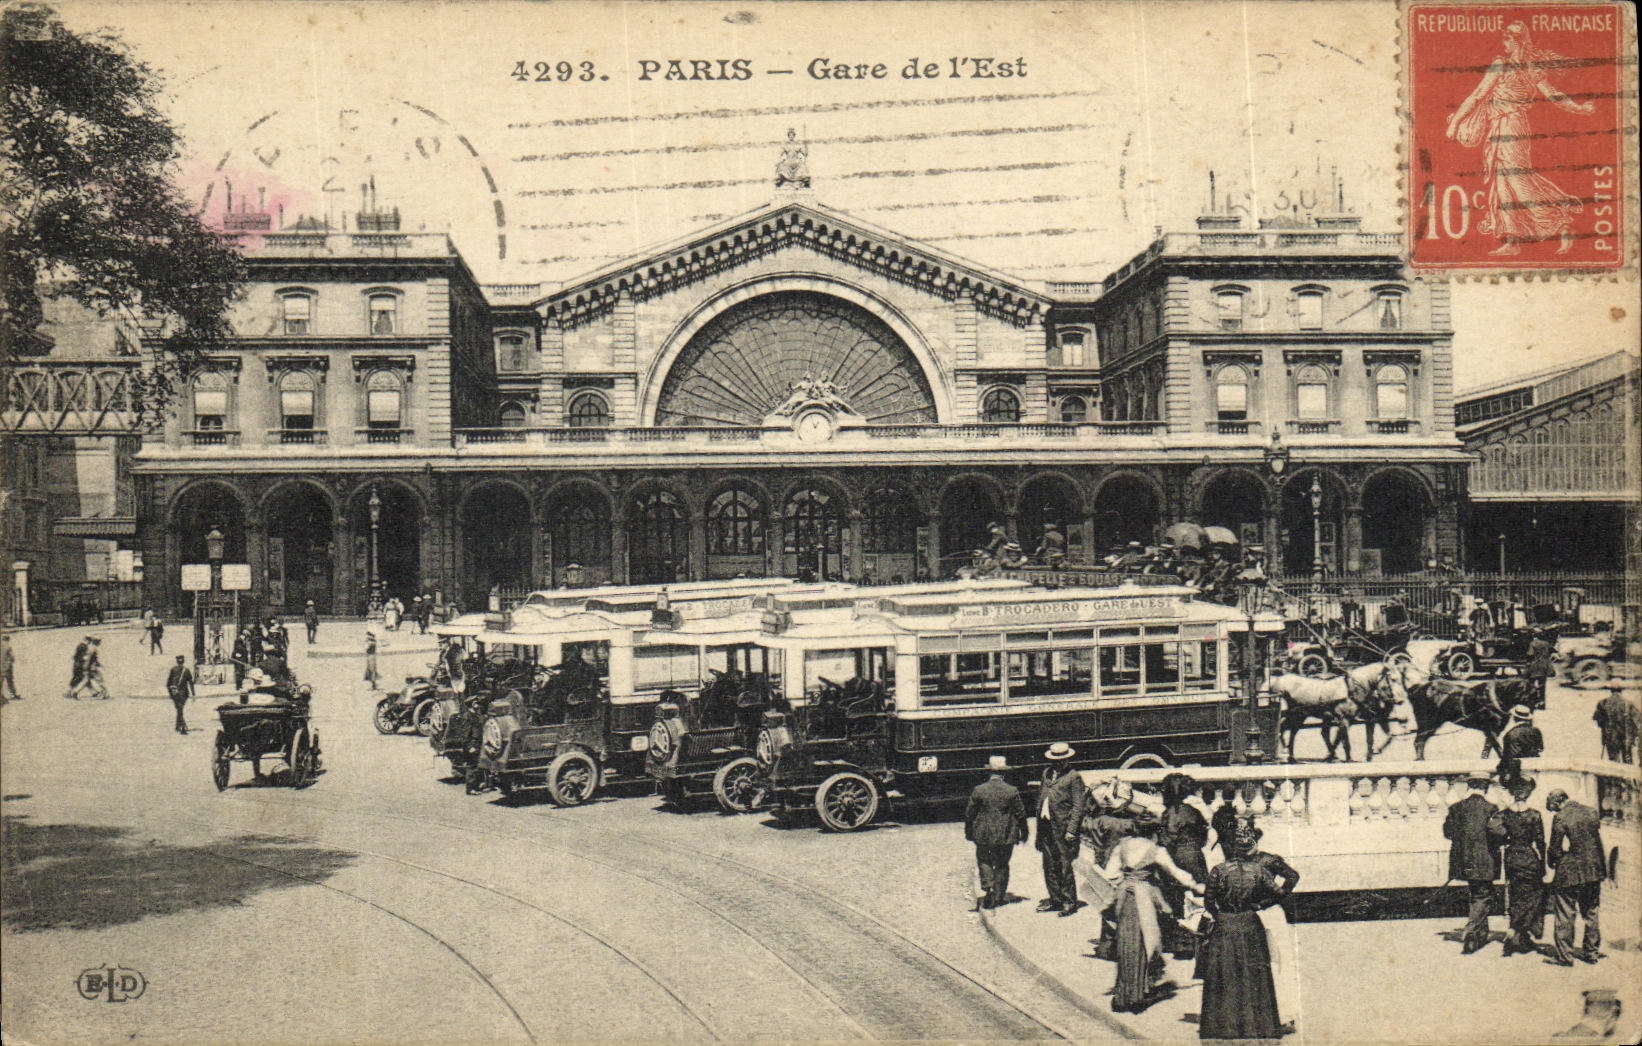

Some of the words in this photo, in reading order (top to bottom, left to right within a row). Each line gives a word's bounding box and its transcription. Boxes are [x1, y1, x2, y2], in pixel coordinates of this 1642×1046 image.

[1531, 13, 1613, 33] FRANÇAISE
[1595, 165, 1613, 252] POSTES
[995, 602, 1080, 617] TROCADERO
[1093, 600, 1129, 611] GARE
